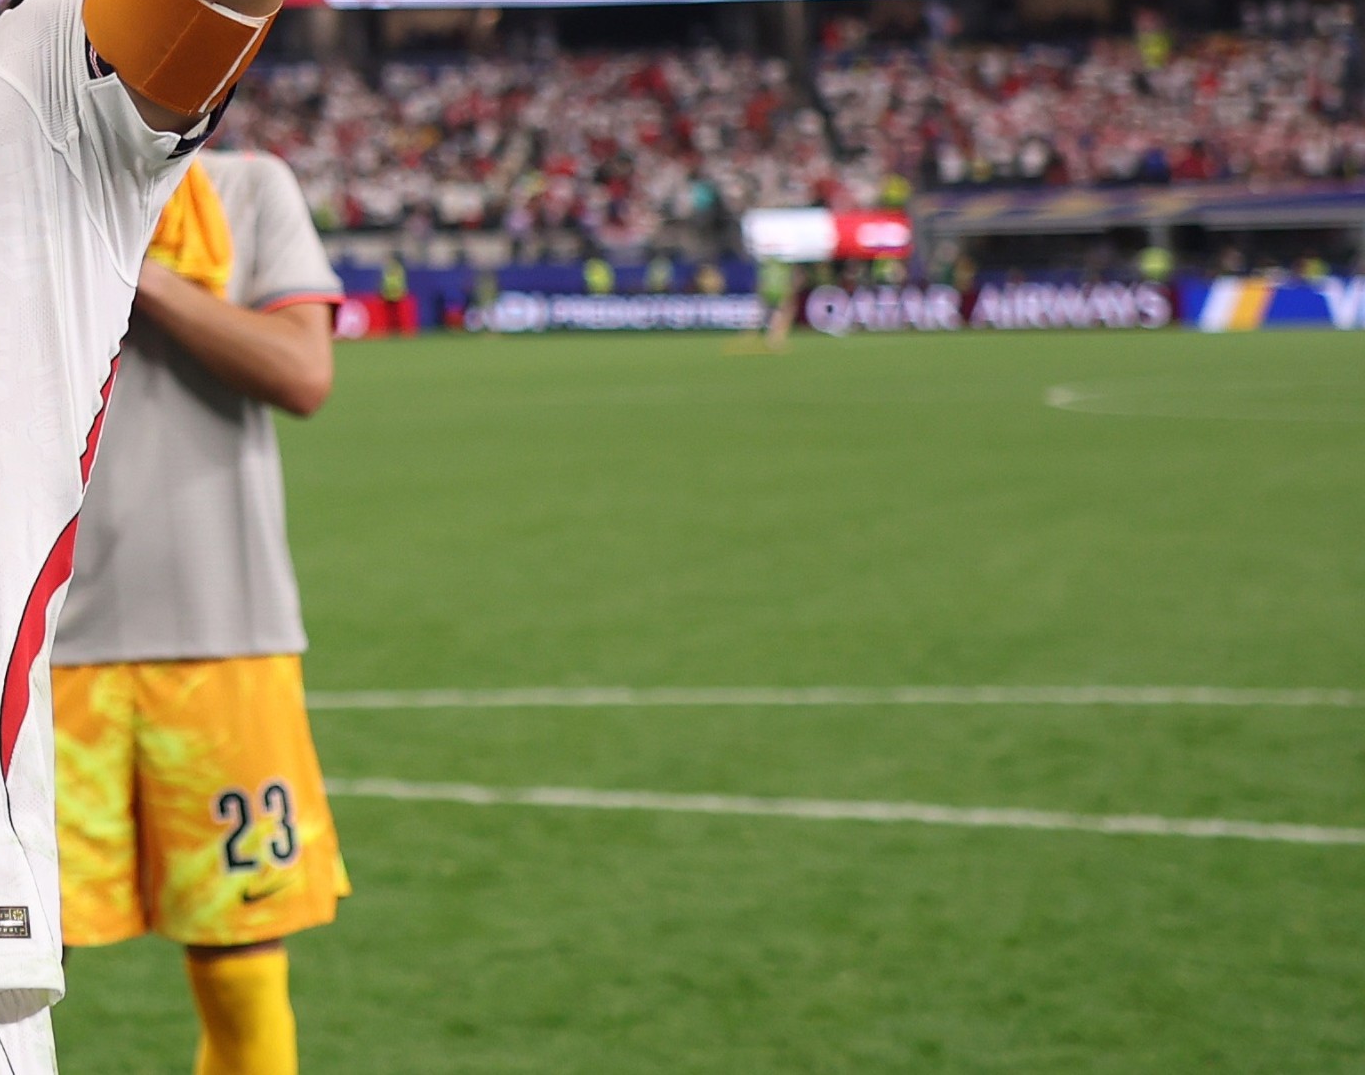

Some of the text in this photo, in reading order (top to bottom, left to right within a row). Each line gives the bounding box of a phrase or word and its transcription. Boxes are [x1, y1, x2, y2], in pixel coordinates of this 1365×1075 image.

[805, 281, 1173, 336] QATAR AIRWAYS
[214, 782, 296, 870] 23
